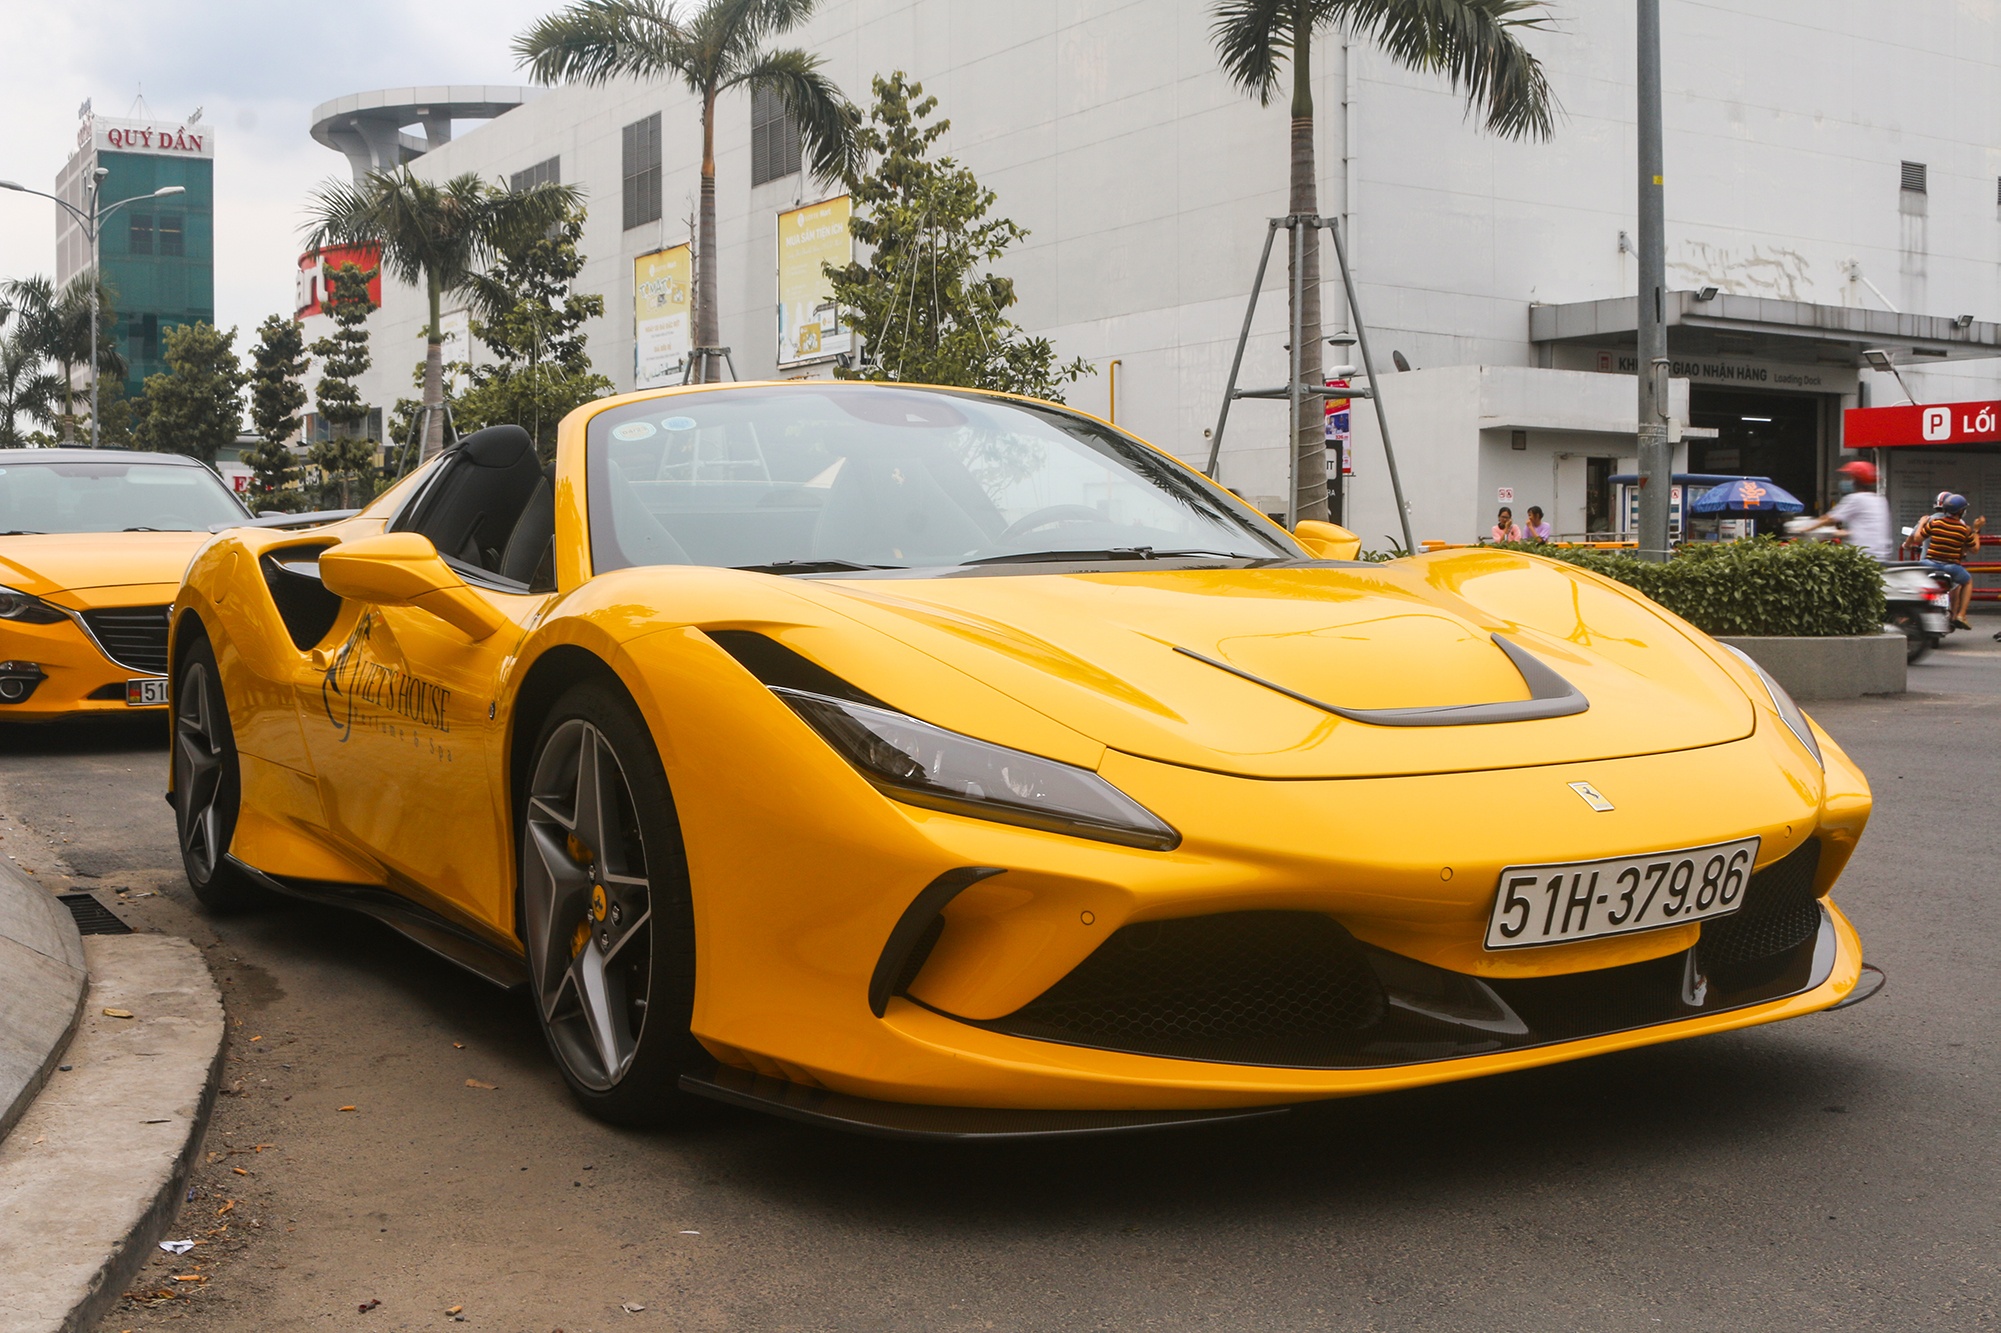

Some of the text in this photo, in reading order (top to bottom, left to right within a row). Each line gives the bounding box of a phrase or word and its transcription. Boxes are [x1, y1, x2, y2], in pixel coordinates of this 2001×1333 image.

[108, 126, 153, 149] QUÝ
[159, 126, 203, 152] DẦN
[786, 234, 800, 247] MUA
[1673, 362, 1699, 377] GIAO
[1703, 362, 1734, 381] NHẬN
[1736, 365, 1768, 382] HÀNG
[1774, 373, 1802, 387] Loading
[1803, 374, 1822, 386] Dock
[1931, 406, 1995, 434] P LỐI
[145, 683, 168, 701] 51
[397, 673, 450, 733] HOUSE
[429, 737, 453, 762] Spa
[1500, 849, 1748, 938] 51H-379.86
